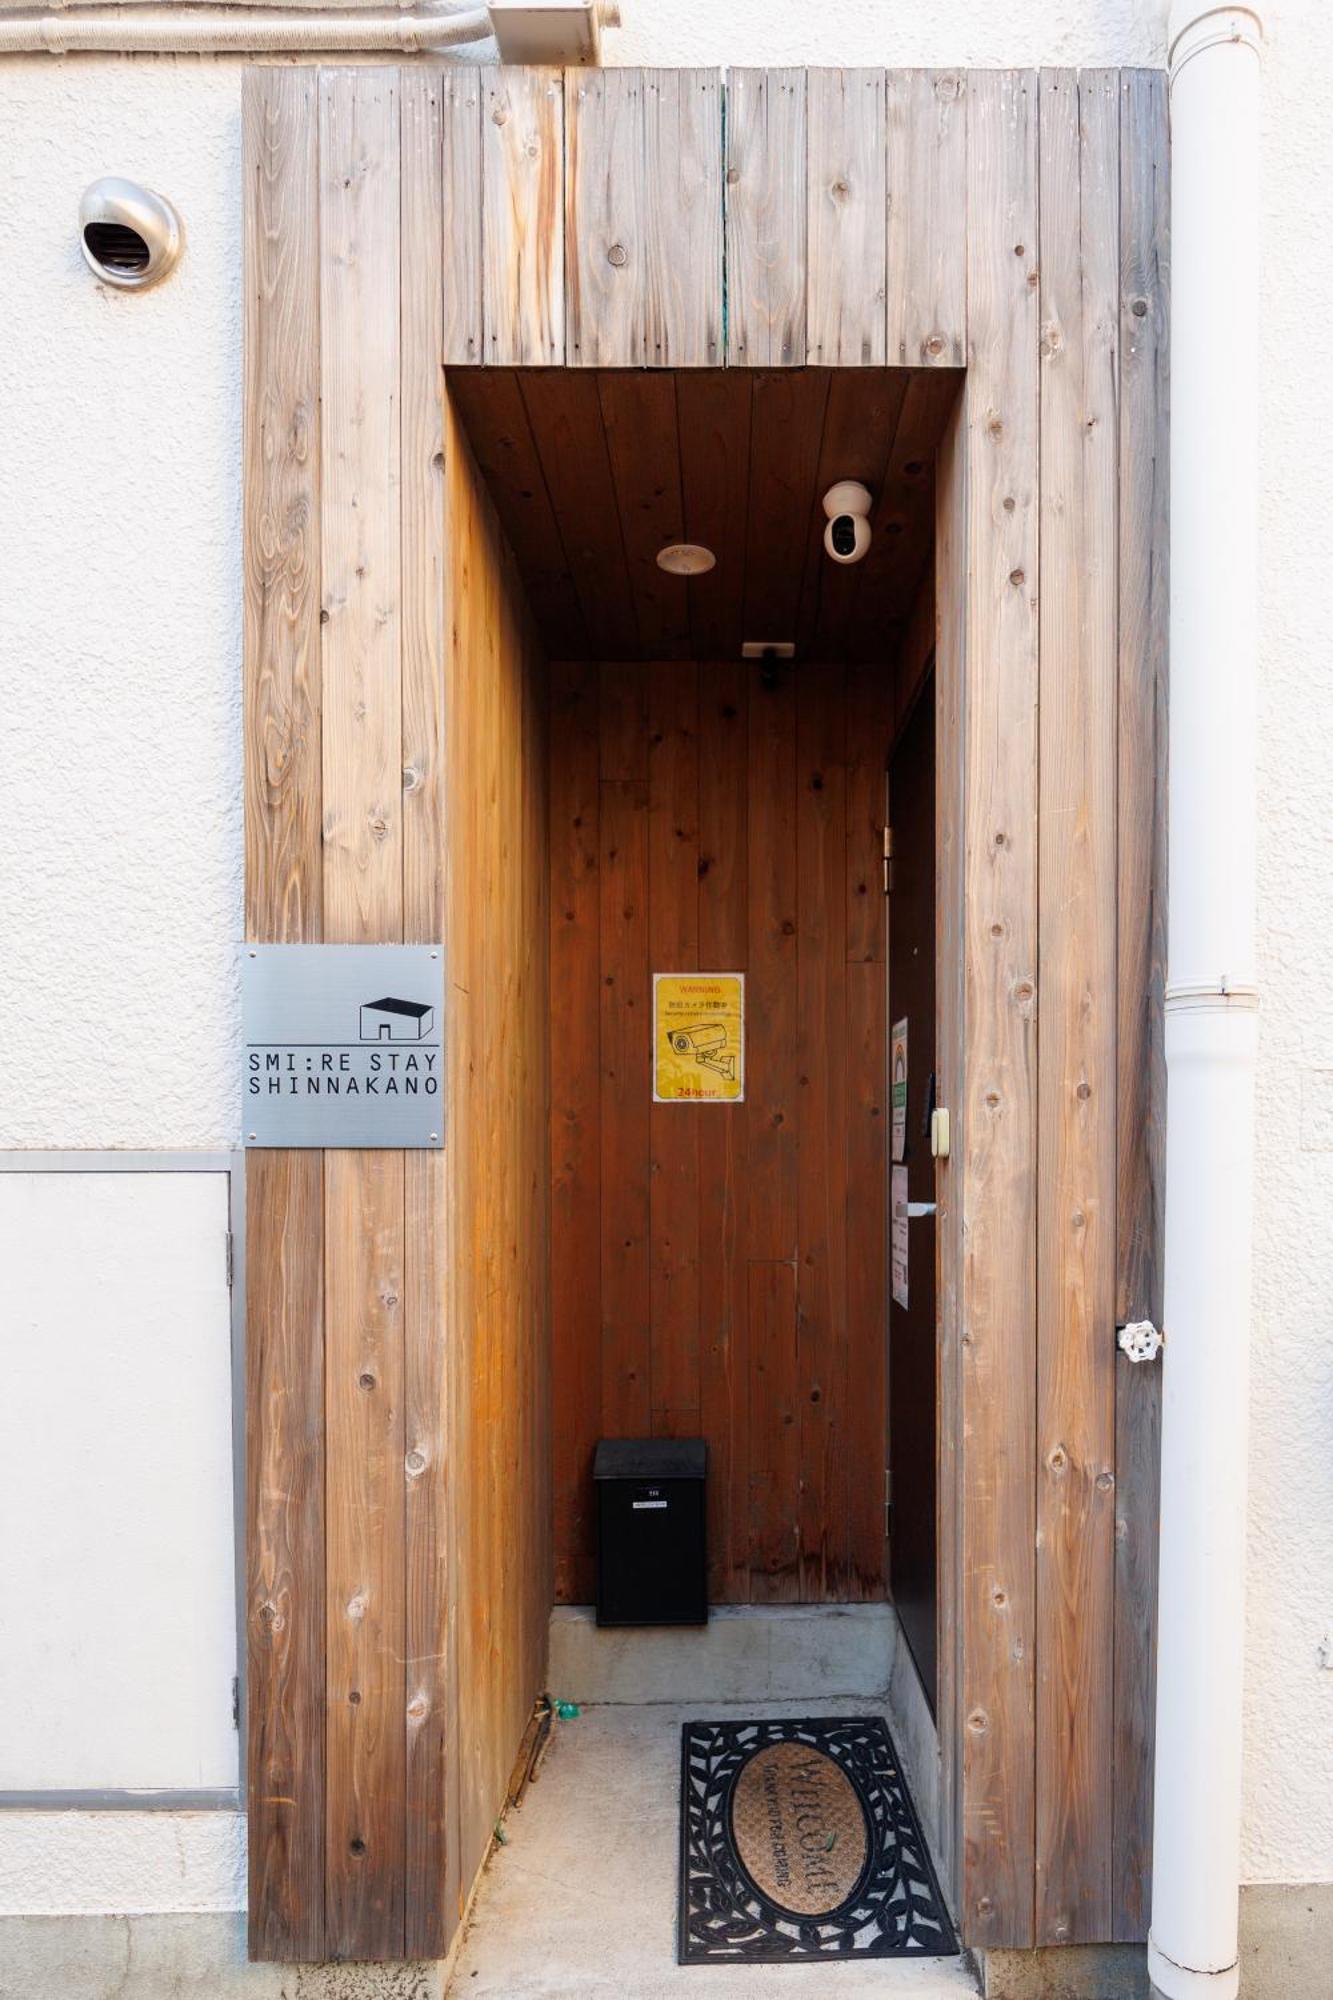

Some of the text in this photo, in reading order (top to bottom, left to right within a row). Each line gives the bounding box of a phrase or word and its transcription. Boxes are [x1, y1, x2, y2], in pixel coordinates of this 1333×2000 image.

[679, 984, 722, 994] WARNING
[249, 1053, 437, 1071] SMI:RE STAY
[249, 1076, 437, 1094] SHINNAKANO
[789, 1758, 841, 1894] WELCOME
